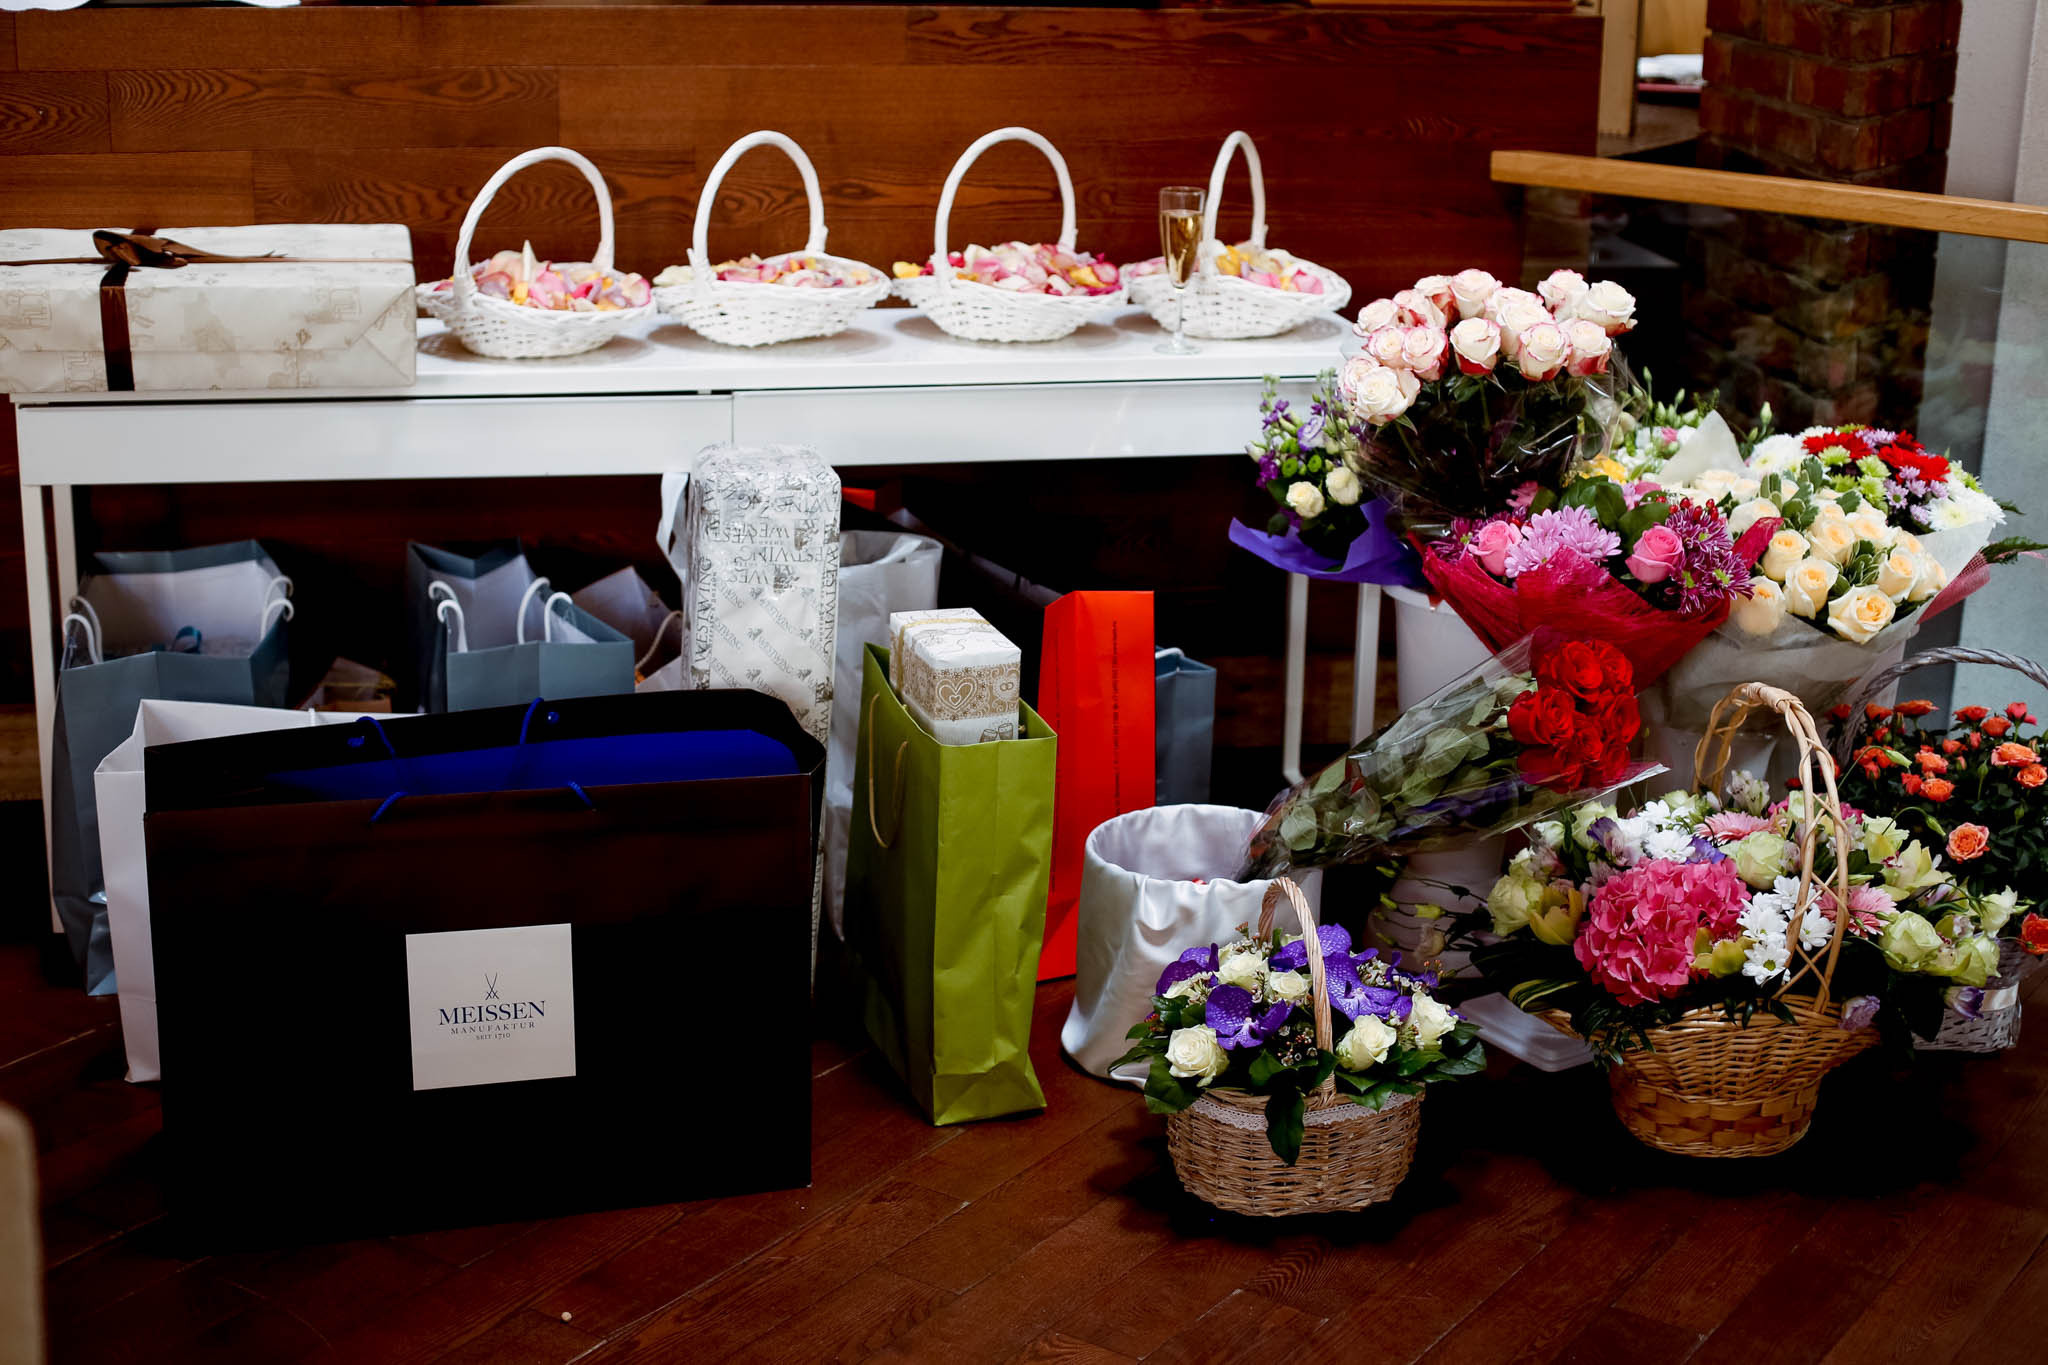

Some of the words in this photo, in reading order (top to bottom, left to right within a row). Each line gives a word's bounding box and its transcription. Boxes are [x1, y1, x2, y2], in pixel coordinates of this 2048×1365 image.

[439, 1000, 546, 1026] MEISSEN
[450, 1021, 536, 1035] MANUFAKTUR
[476, 1033, 492, 1041] SEIT
[494, 1032, 511, 1041] 1710
